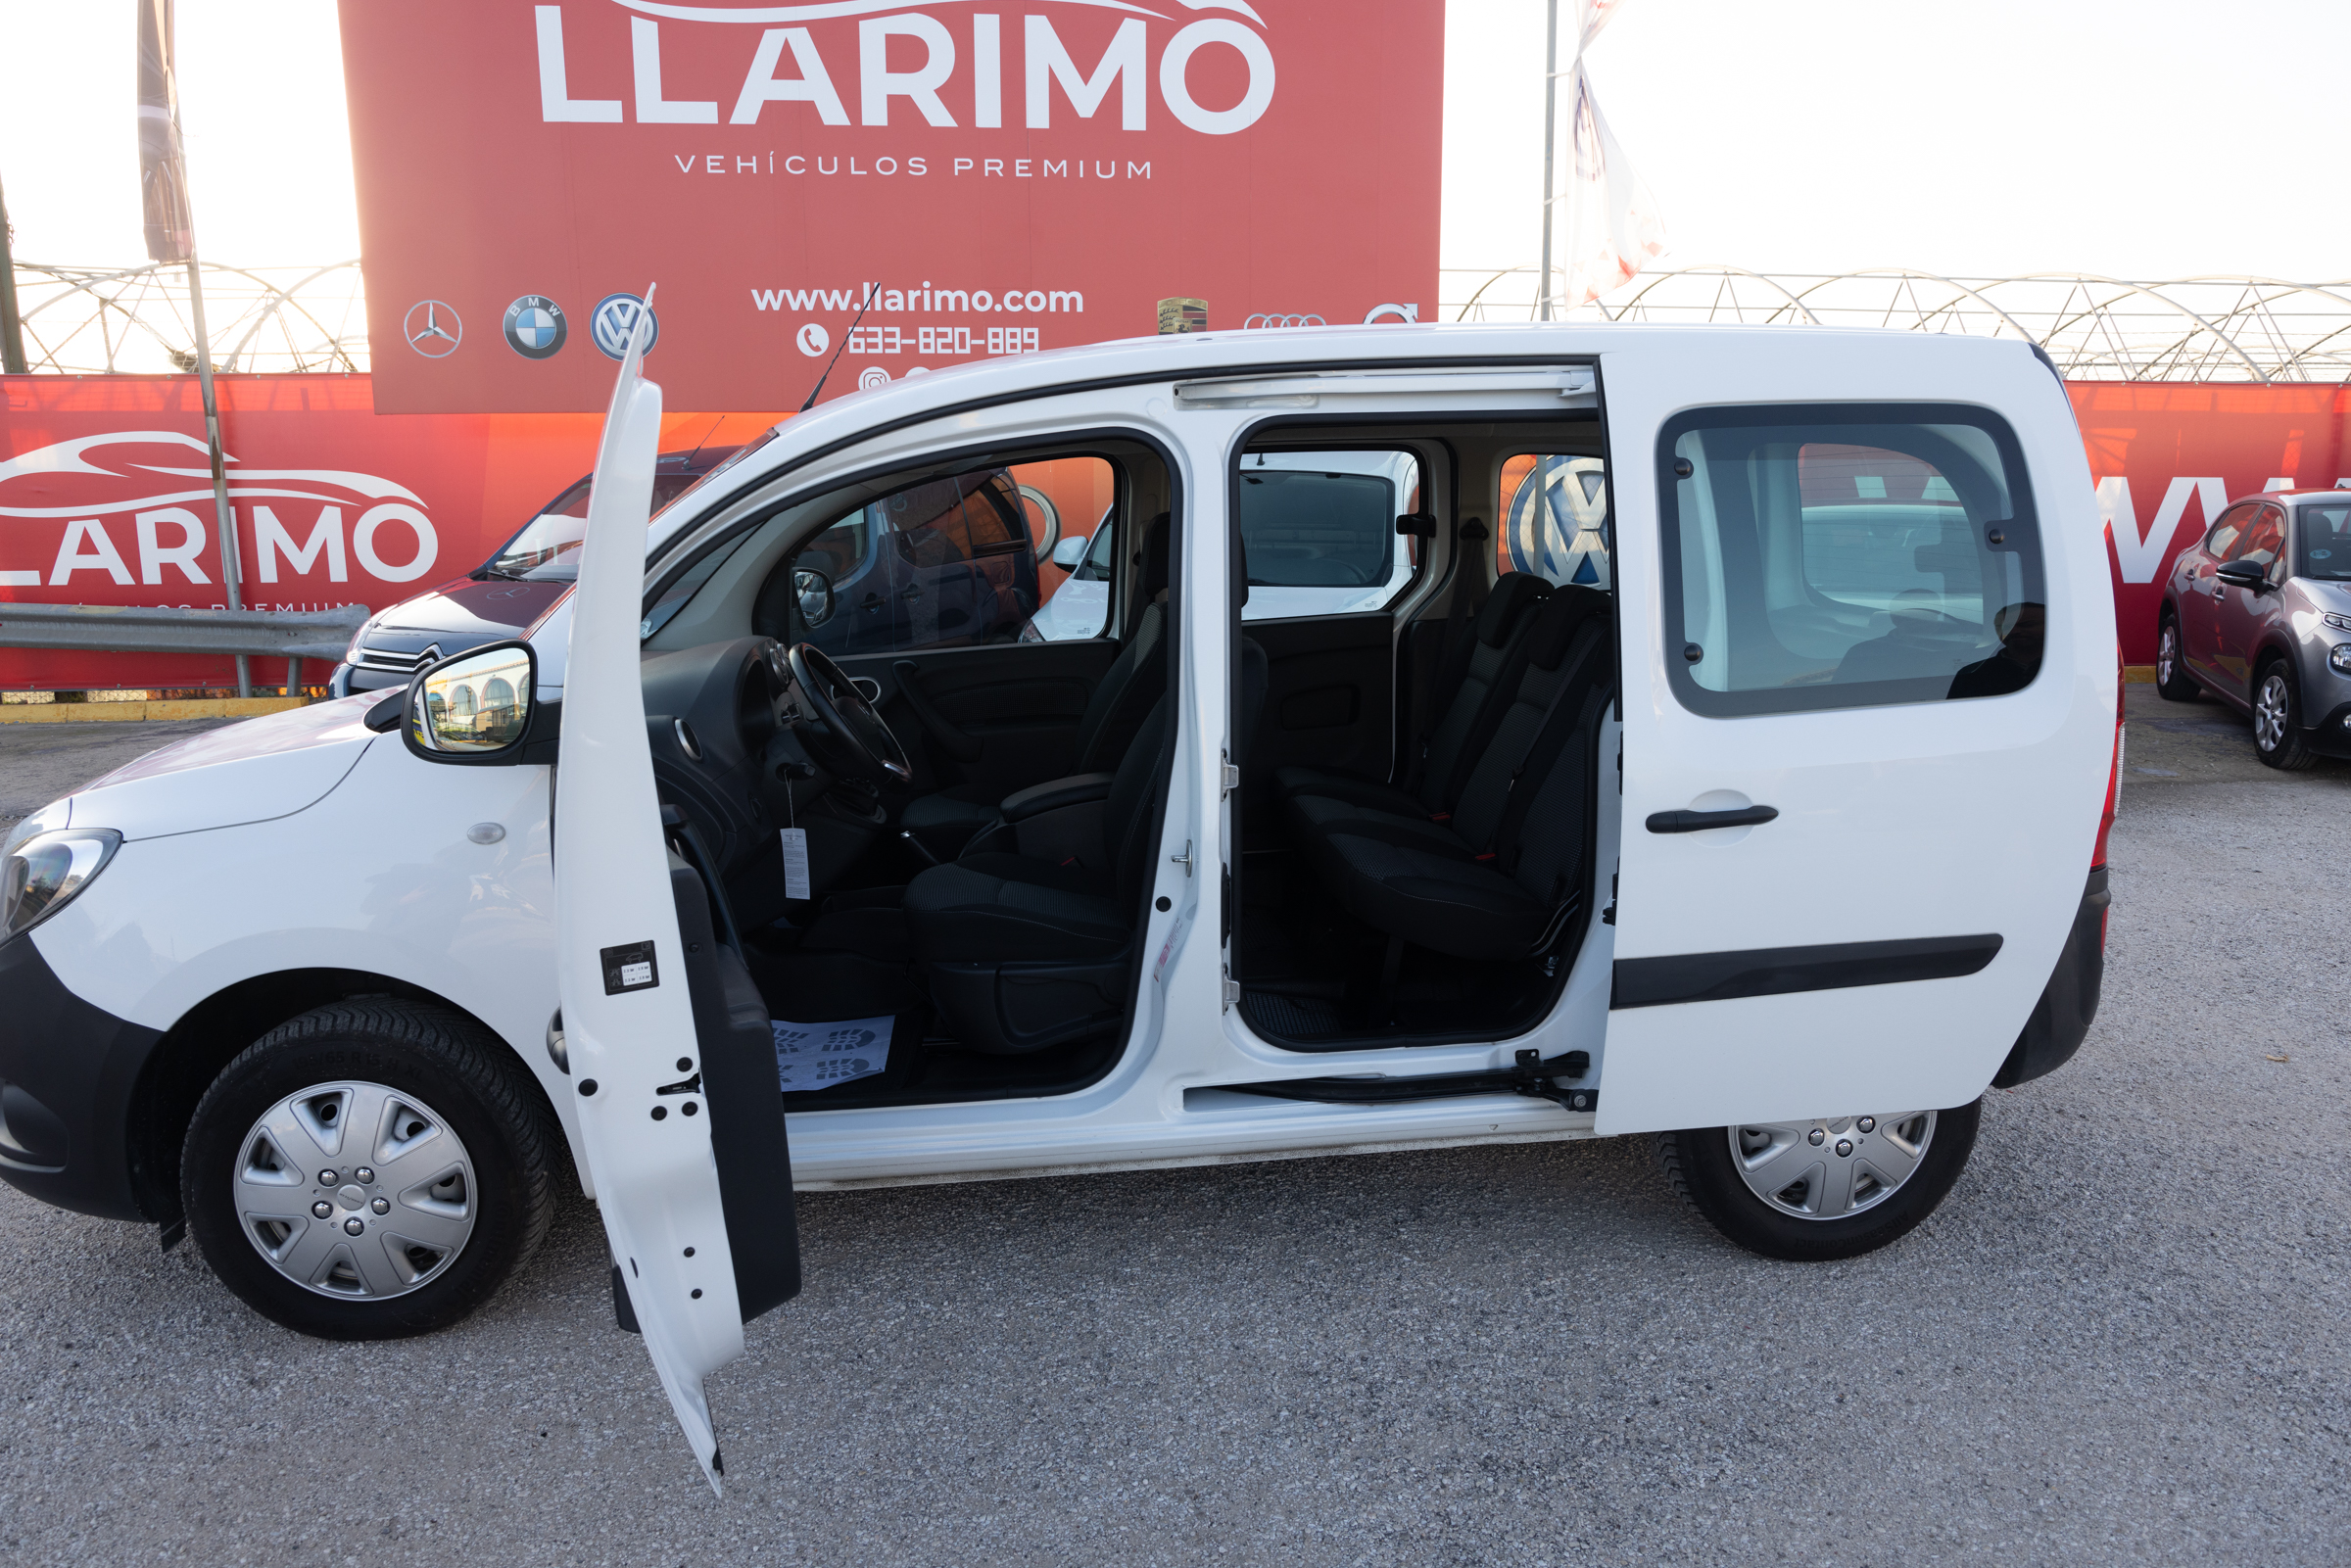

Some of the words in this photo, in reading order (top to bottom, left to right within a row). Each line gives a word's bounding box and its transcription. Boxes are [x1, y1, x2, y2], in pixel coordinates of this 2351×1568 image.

[535, 5, 1275, 135] LLARIMO
[674, 151, 928, 176] VEHÍCULOS
[954, 158, 1151, 179] PREMIUM
[508, 297, 560, 317] BMW
[750, 280, 1083, 313] www.llarimo.com
[847, 326, 1039, 355] 633-820-889
